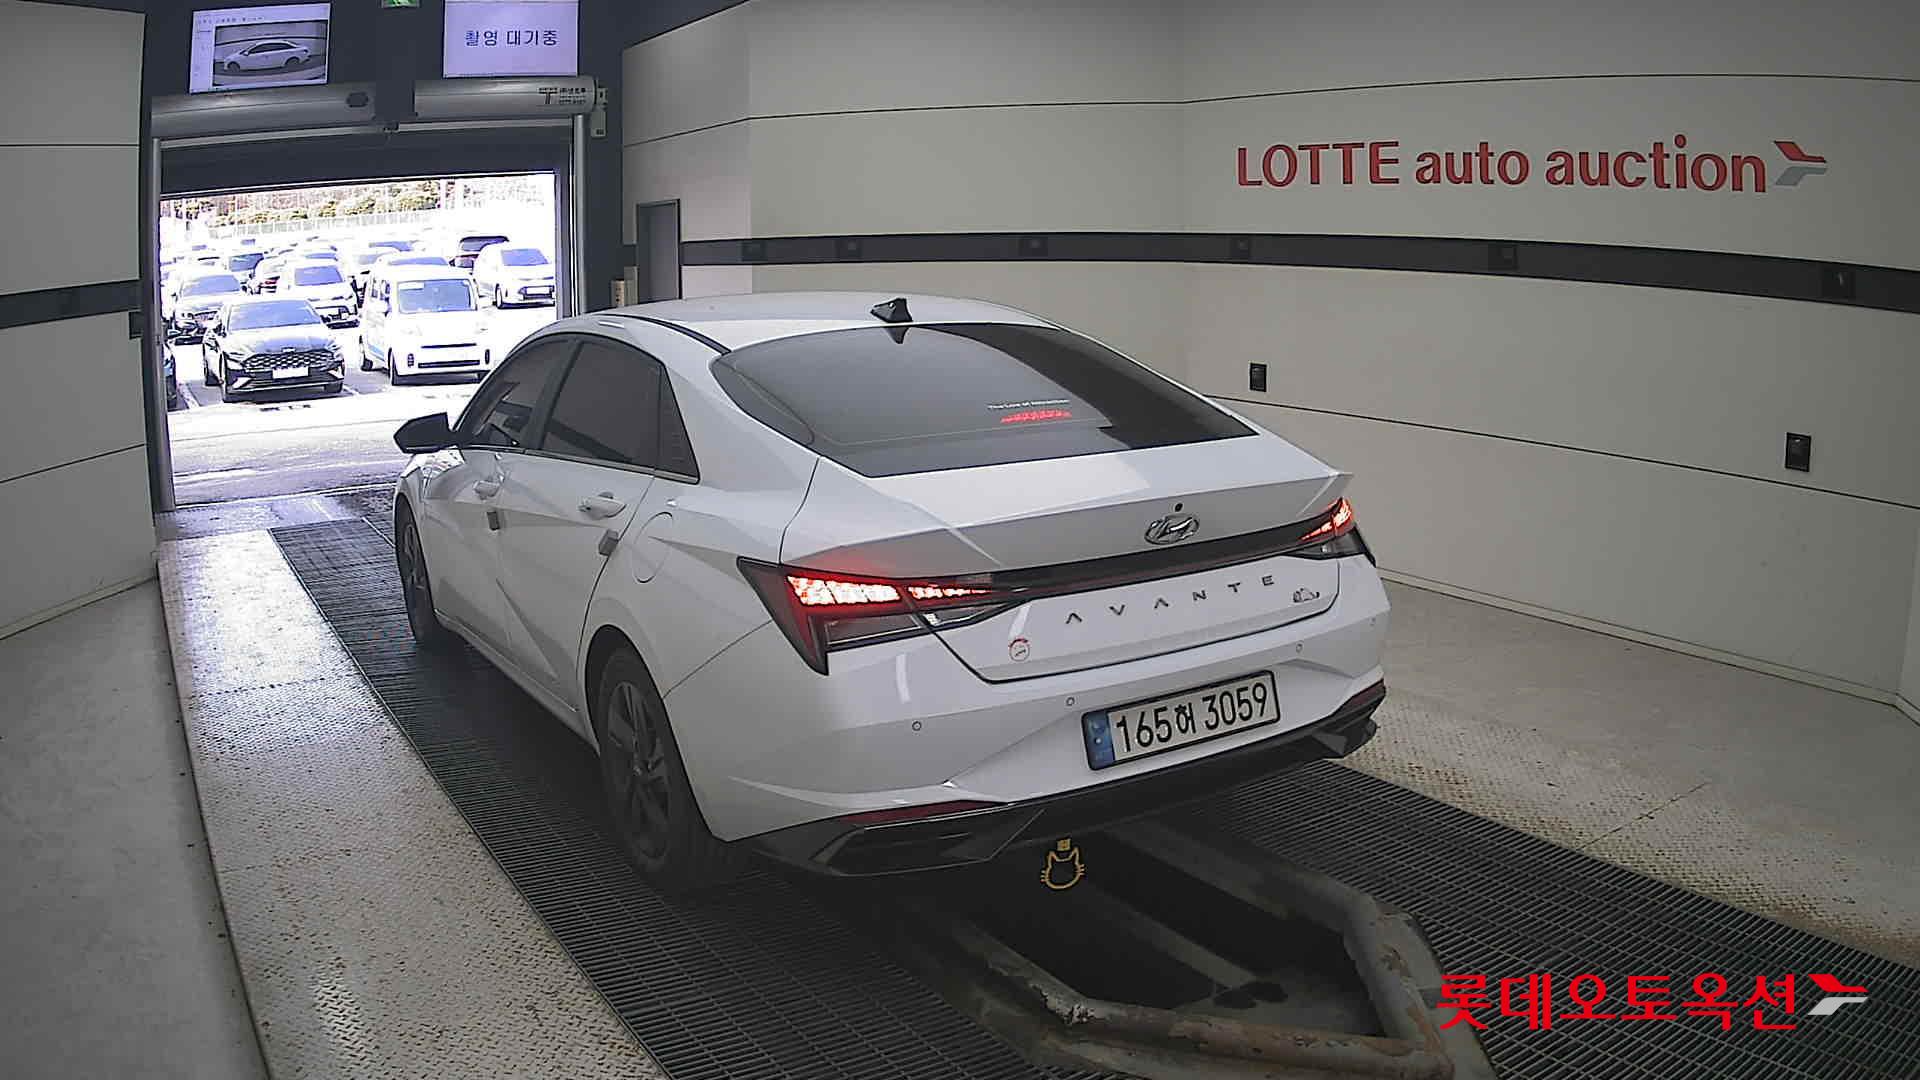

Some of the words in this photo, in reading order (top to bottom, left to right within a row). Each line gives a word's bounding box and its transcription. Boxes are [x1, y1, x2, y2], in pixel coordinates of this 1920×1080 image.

[465, 30, 498, 47] 촬영
[506, 30, 558, 46] 대기중
[1237, 141, 1400, 187] LOTTE
[1415, 142, 1530, 185] auto
[1545, 134, 1767, 193] auction
[1064, 575, 1275, 625] AVANTE
[1116, 702, 1197, 753] 165허
[1201, 682, 1268, 730] 3059
